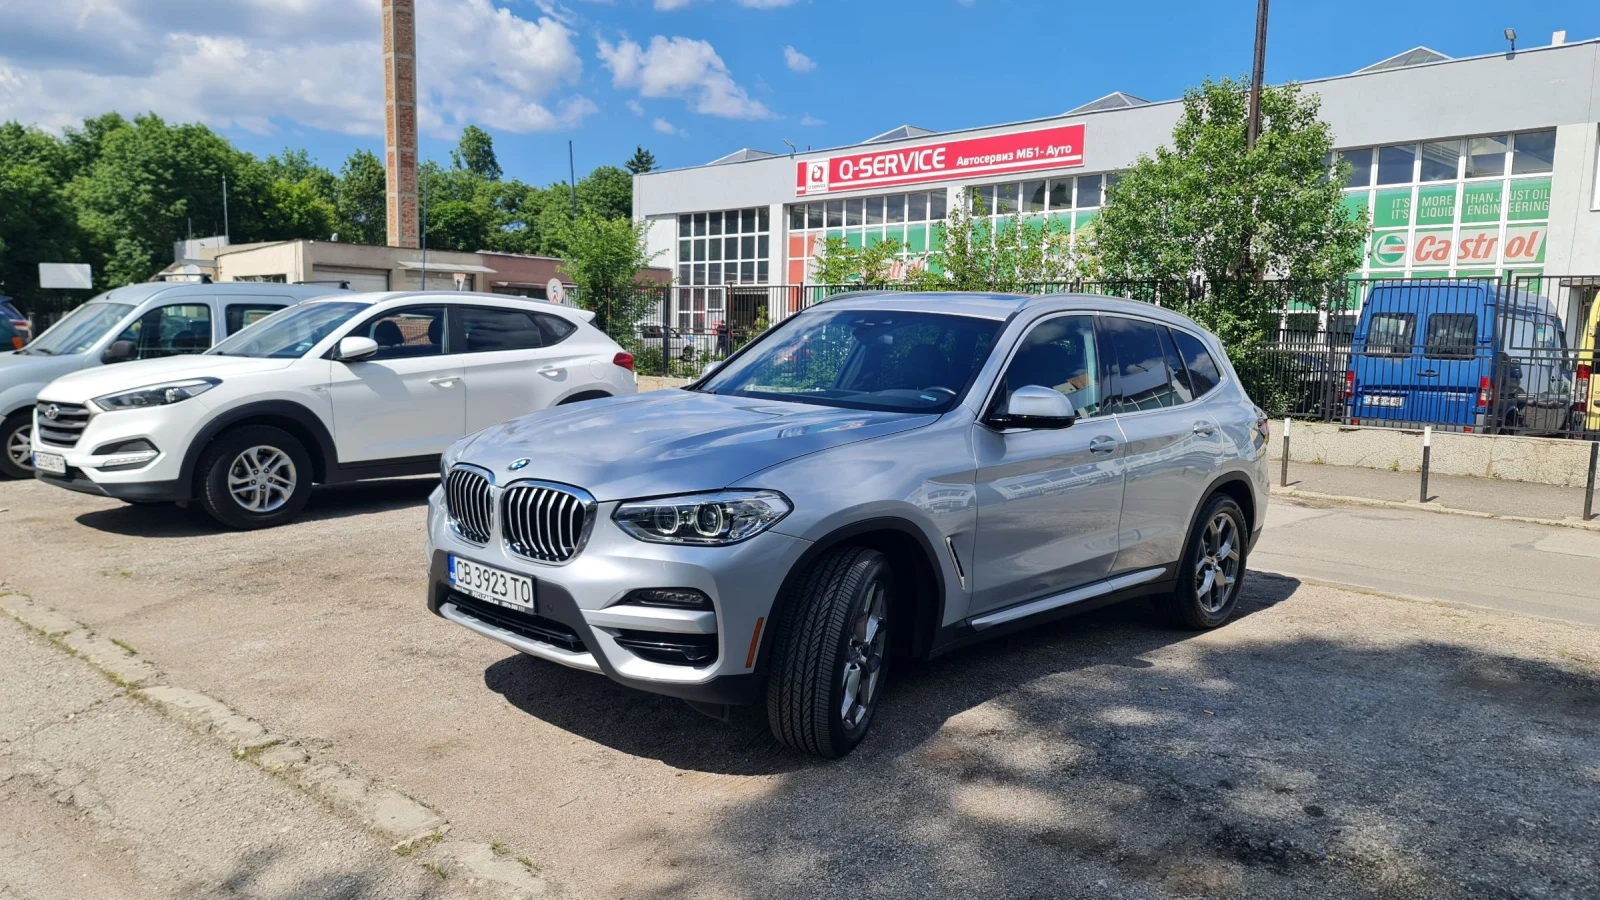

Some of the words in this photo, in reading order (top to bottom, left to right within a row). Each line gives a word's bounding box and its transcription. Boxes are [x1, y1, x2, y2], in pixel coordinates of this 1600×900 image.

[839, 147, 946, 180] Q-SERVICE
[956, 152, 1014, 167] Автосервиз
[1046, 144, 1073, 157] Ауто
[1391, 208, 1410, 220] IT'S
[1420, 206, 1455, 218] LIQUID
[1467, 200, 1550, 215] ENGINEERING
[1392, 198, 1411, 209] IT'S
[1421, 195, 1453, 207] MORE
[1465, 192, 1494, 204] THAN
[1532, 188, 1550, 200] OIL
[1415, 231, 1539, 262] Castrol
[456, 560, 472, 585] CB
[475, 566, 508, 597] 3923
